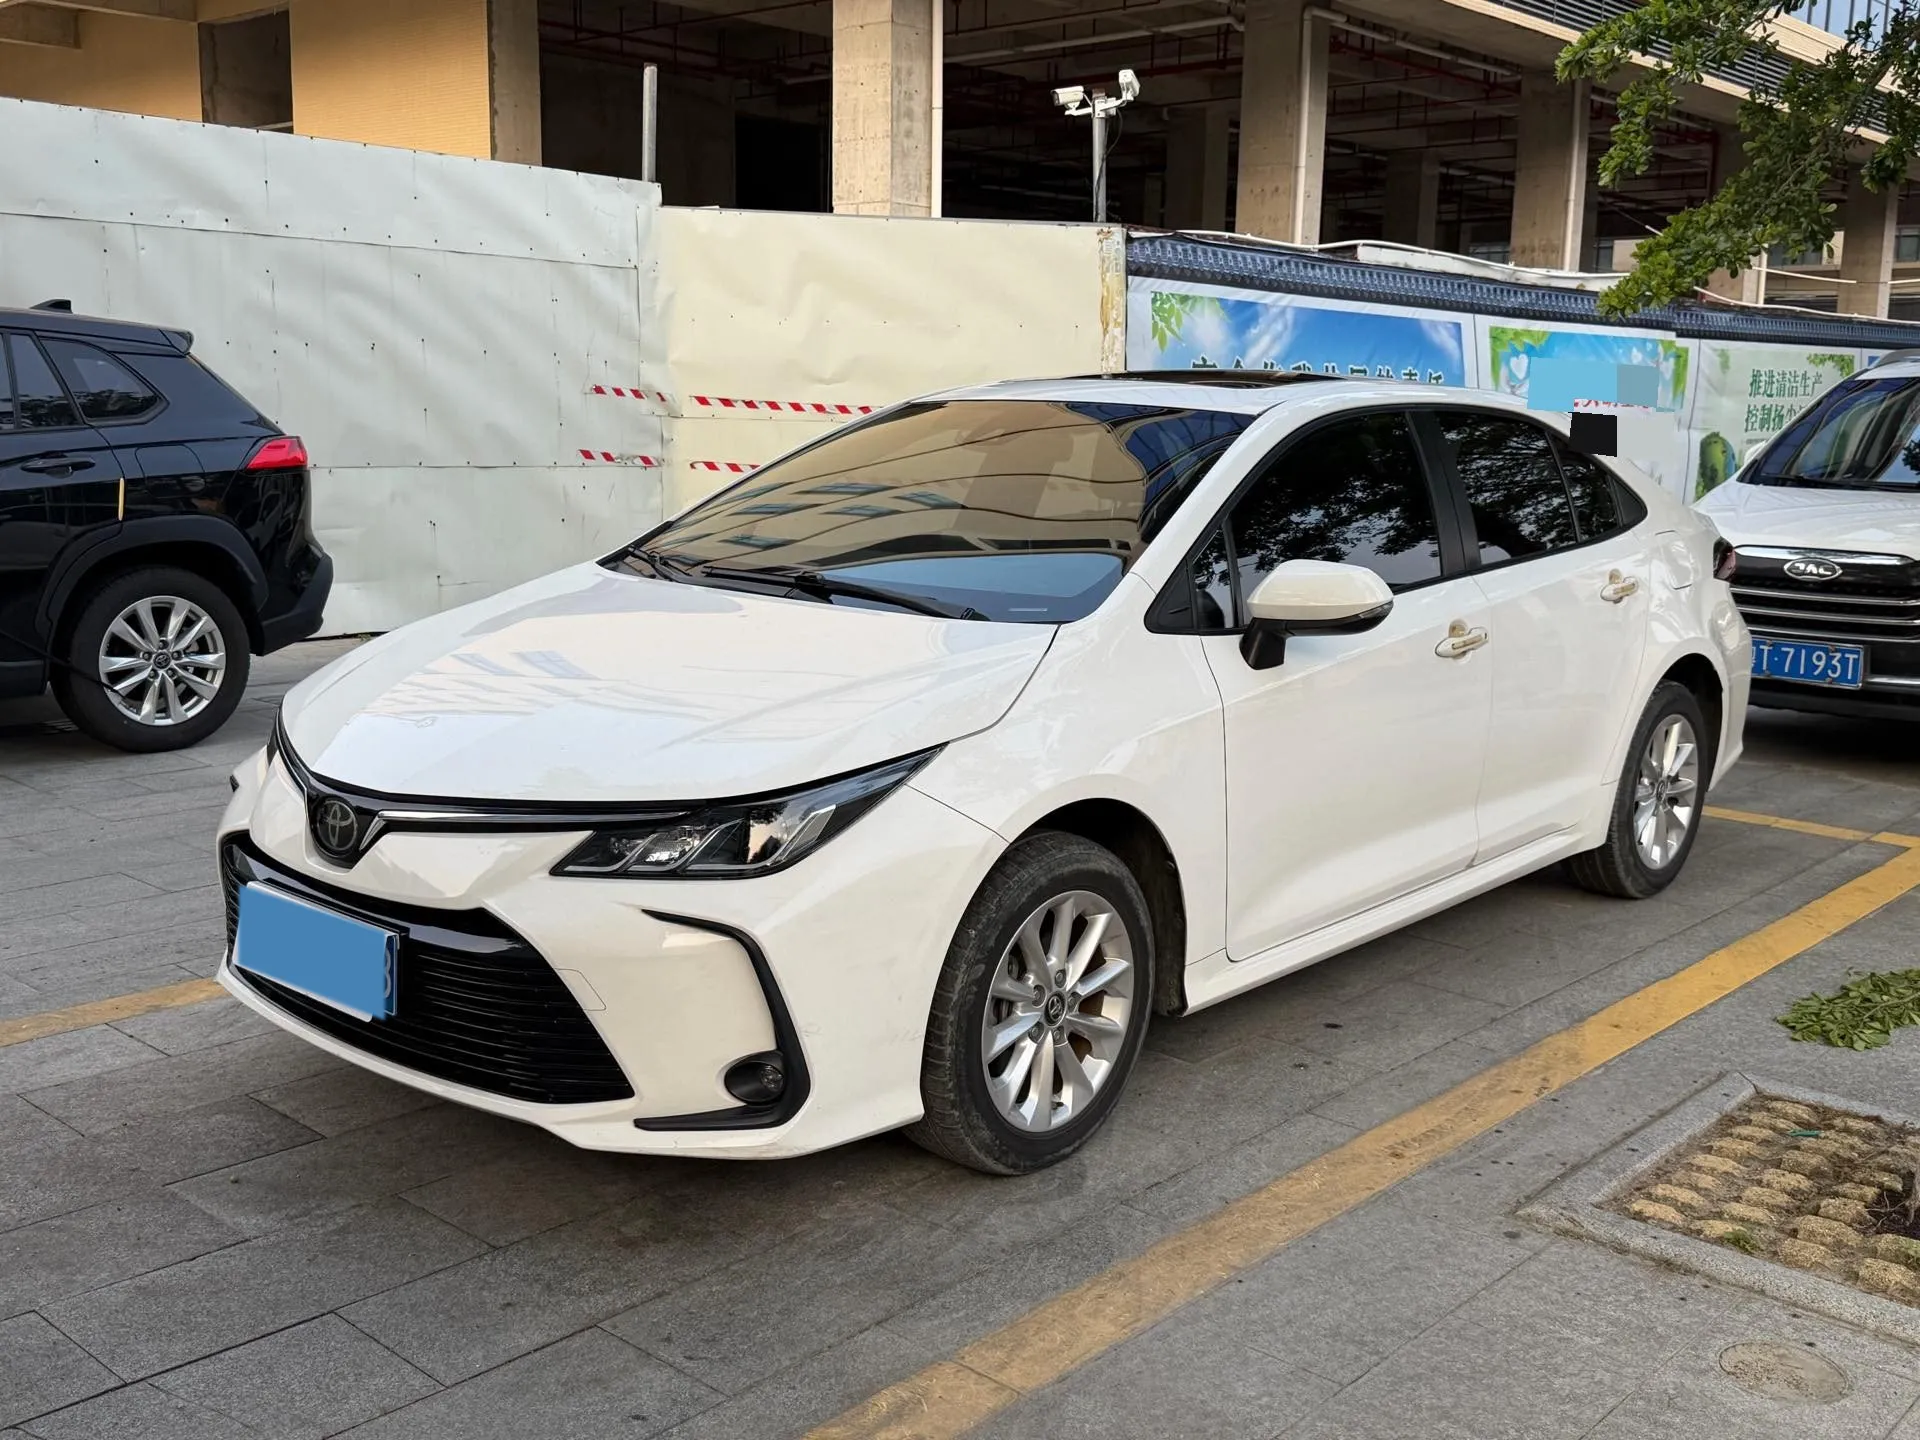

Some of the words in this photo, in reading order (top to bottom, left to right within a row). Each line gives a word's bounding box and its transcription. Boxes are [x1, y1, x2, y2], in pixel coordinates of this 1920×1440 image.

[1748, 368, 1823, 398] 推进清洁生产
[1744, 403, 1805, 433] 控制扬尘
[1791, 562, 1833, 576] JAC
[1751, 645, 1859, 680] T·7193T
